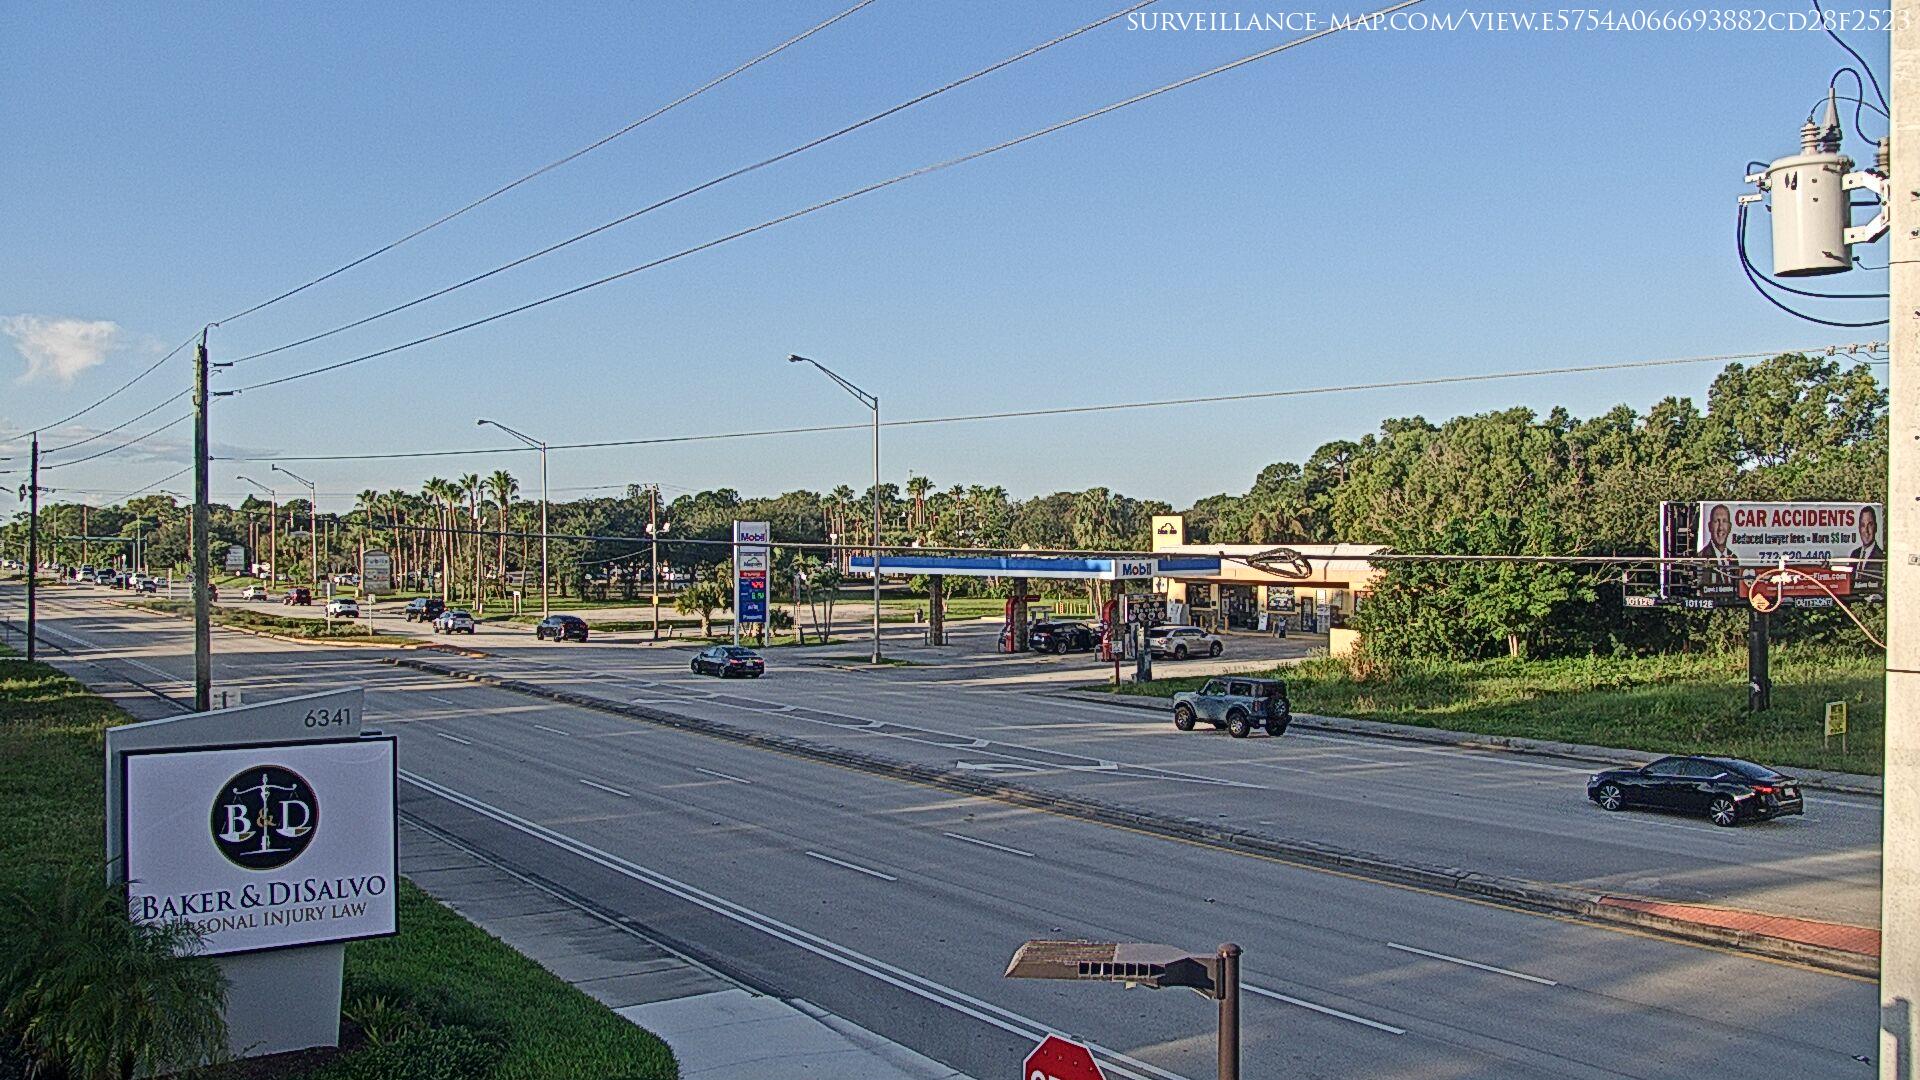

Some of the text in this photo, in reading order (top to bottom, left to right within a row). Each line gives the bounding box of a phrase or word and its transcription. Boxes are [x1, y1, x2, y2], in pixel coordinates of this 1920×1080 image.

[1734, 509, 1856, 528] CAR ACCIDENTS
[740, 532, 766, 542] Mobil
[1122, 563, 1152, 576] Mobil
[303, 708, 351, 728] 6341
[143, 891, 233, 920] BAKER
[240, 884, 261, 908] &
[168, 902, 368, 936] RSONAL INJURY LAW
